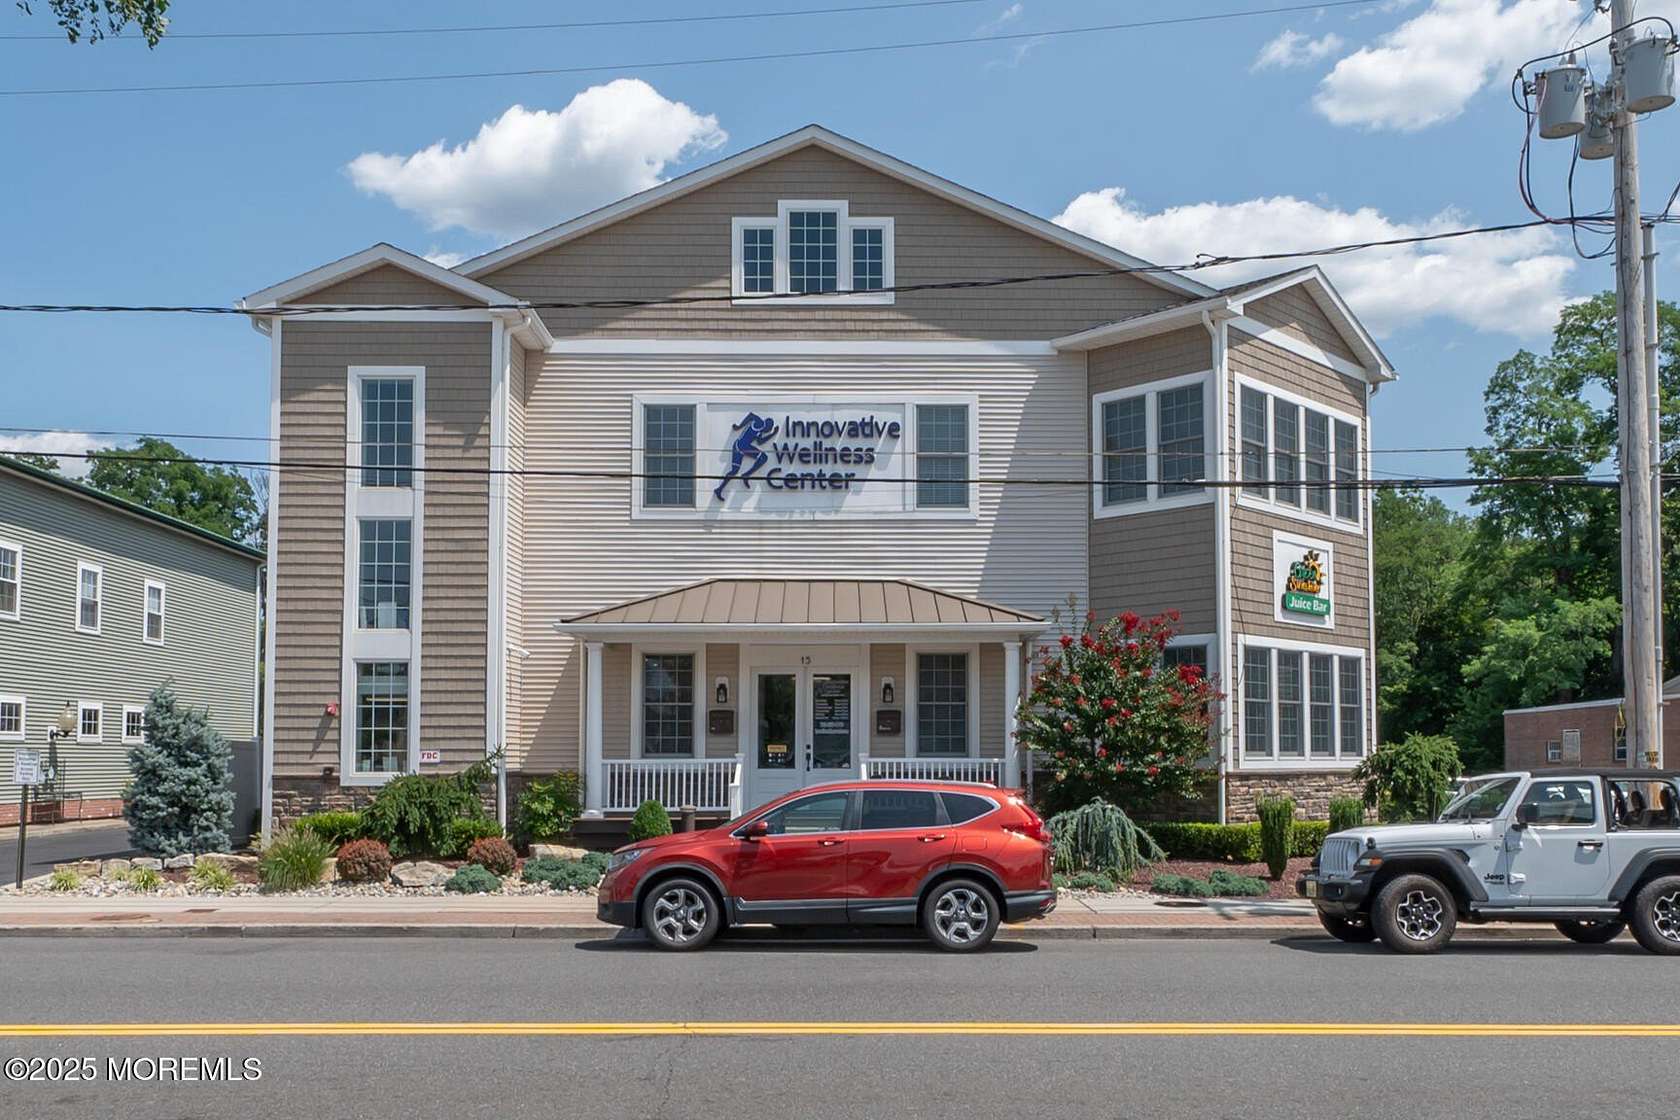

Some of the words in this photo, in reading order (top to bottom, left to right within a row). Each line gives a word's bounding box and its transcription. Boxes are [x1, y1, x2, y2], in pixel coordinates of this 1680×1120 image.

[785, 415, 901, 438] Innovative
[773, 441, 876, 465] Wellness
[766, 467, 856, 490] Center
[1289, 596, 1312, 610] Juice
[1312, 599, 1328, 612] Bar
[1483, 872, 1505, 880] Jeep
